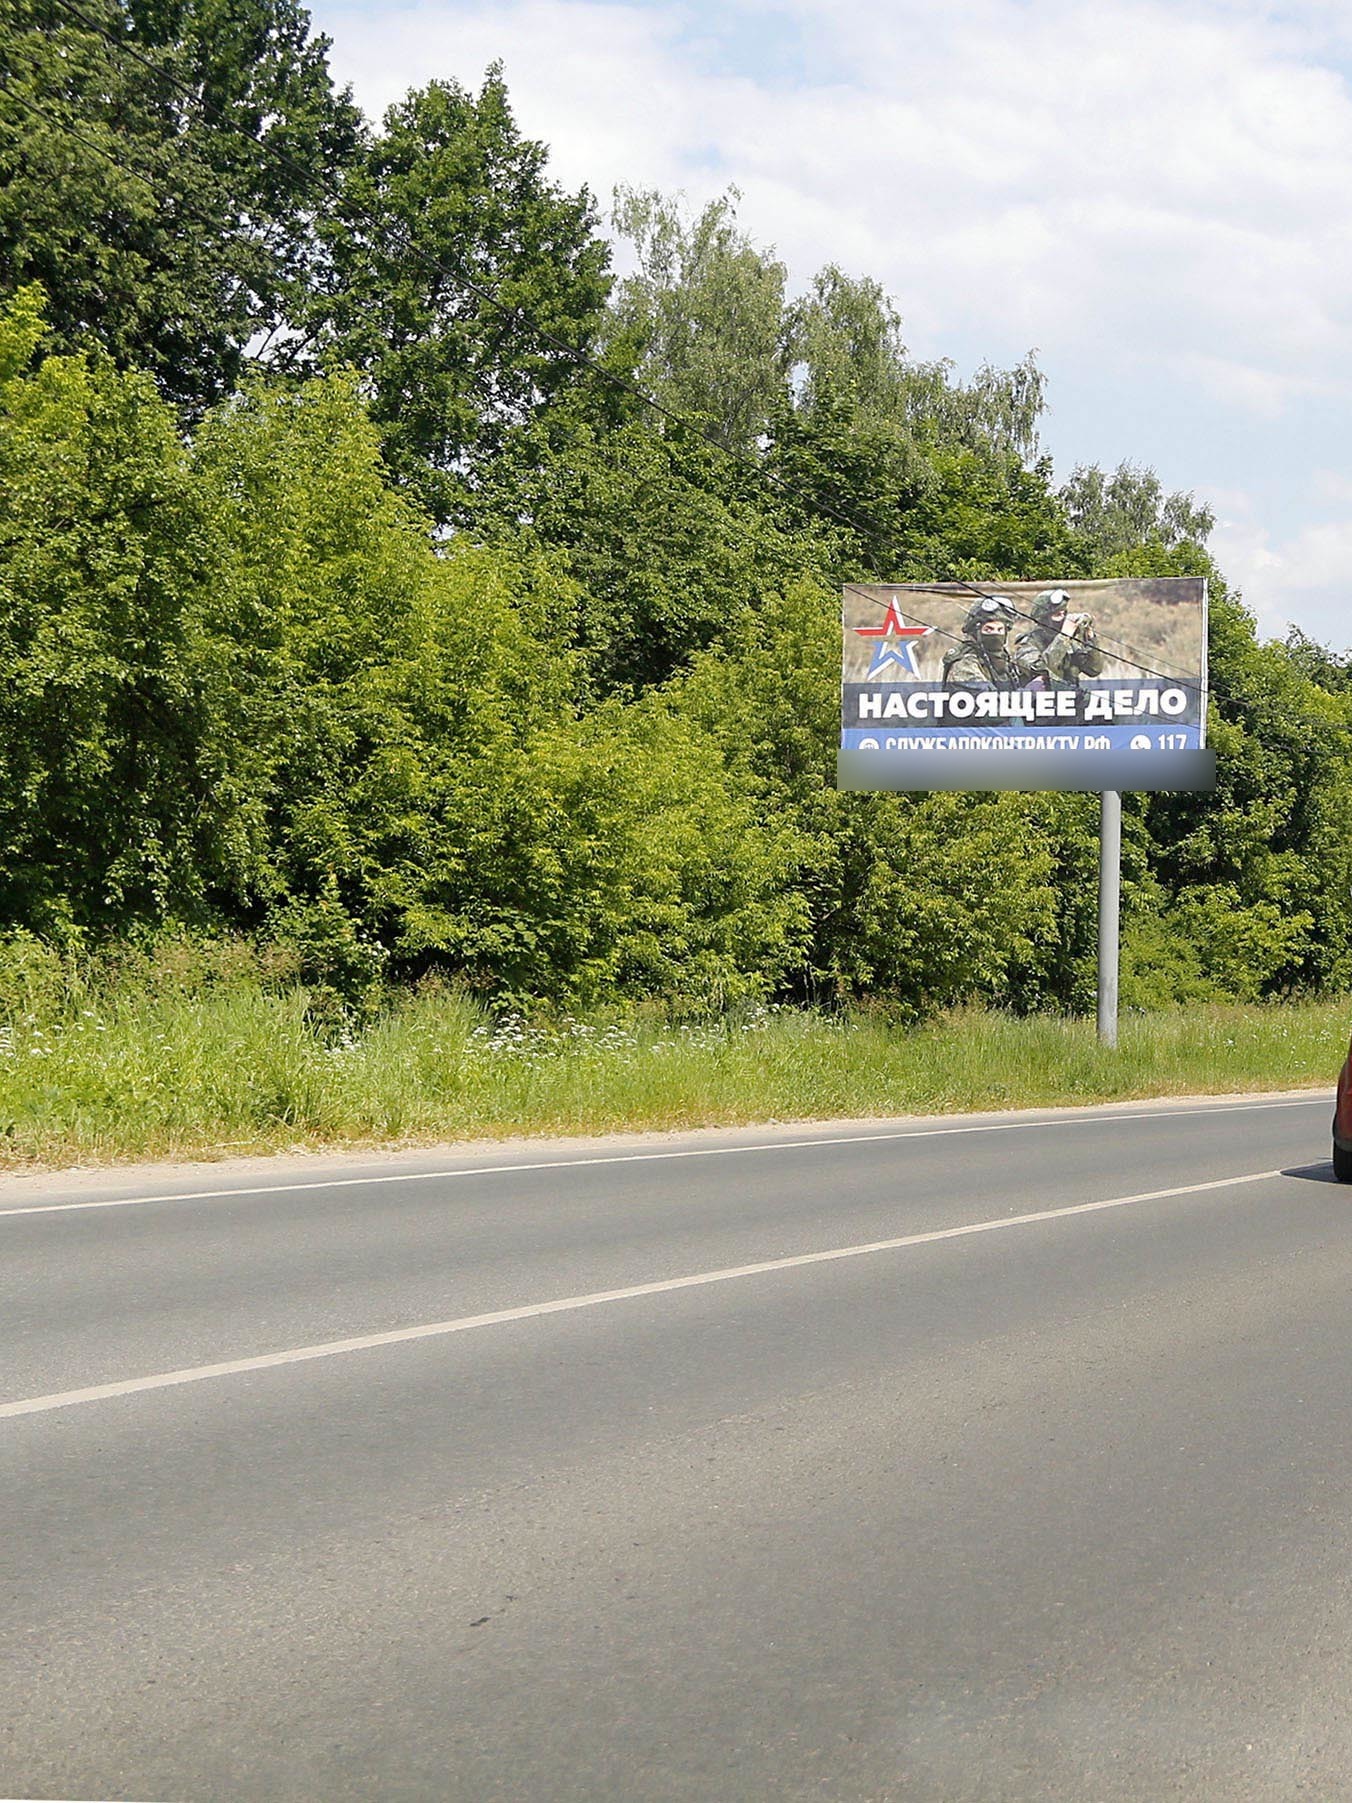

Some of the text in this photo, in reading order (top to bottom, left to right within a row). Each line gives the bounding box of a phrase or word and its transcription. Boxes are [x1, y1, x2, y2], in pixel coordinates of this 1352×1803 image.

[858, 688, 1187, 721] НАСТОЯЩЕЕ ДЕЛО
[1157, 734, 1187, 750] 117
